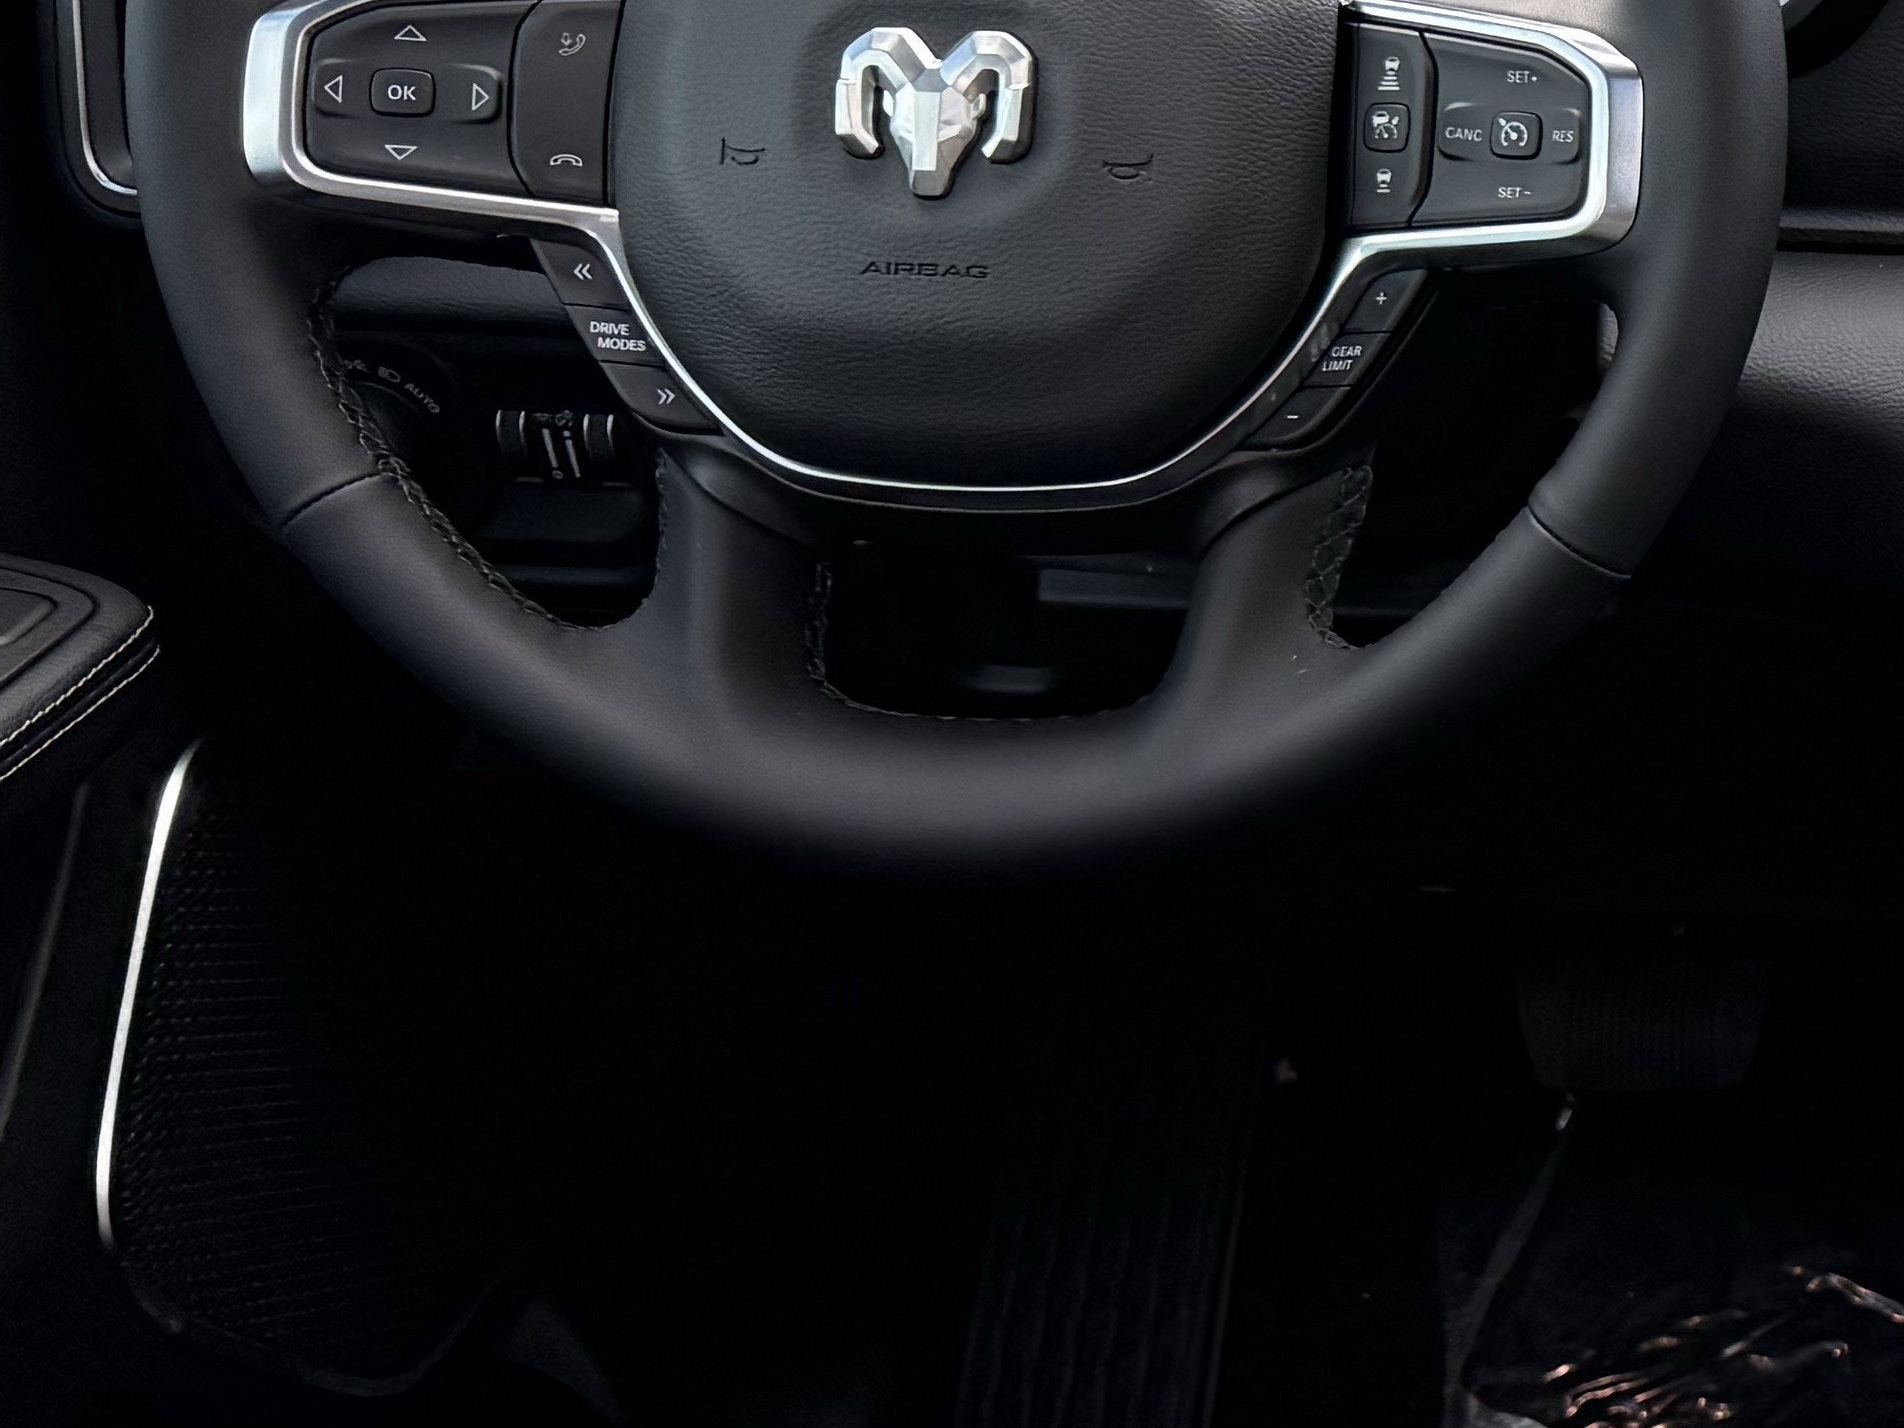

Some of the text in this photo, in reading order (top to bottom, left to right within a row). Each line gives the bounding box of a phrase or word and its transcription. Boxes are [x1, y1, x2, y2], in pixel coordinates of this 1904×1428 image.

[386, 82, 418, 102] OK
[1444, 126, 1484, 143] CANC
[1551, 129, 1574, 143] RES
[859, 259, 991, 280] AIRBAG
[589, 320, 631, 337] DRIVE
[596, 335, 648, 353] MODES
[1331, 345, 1363, 358] GEAR
[1322, 358, 1354, 372] LIMIT
[404, 382, 442, 415] AUTO
